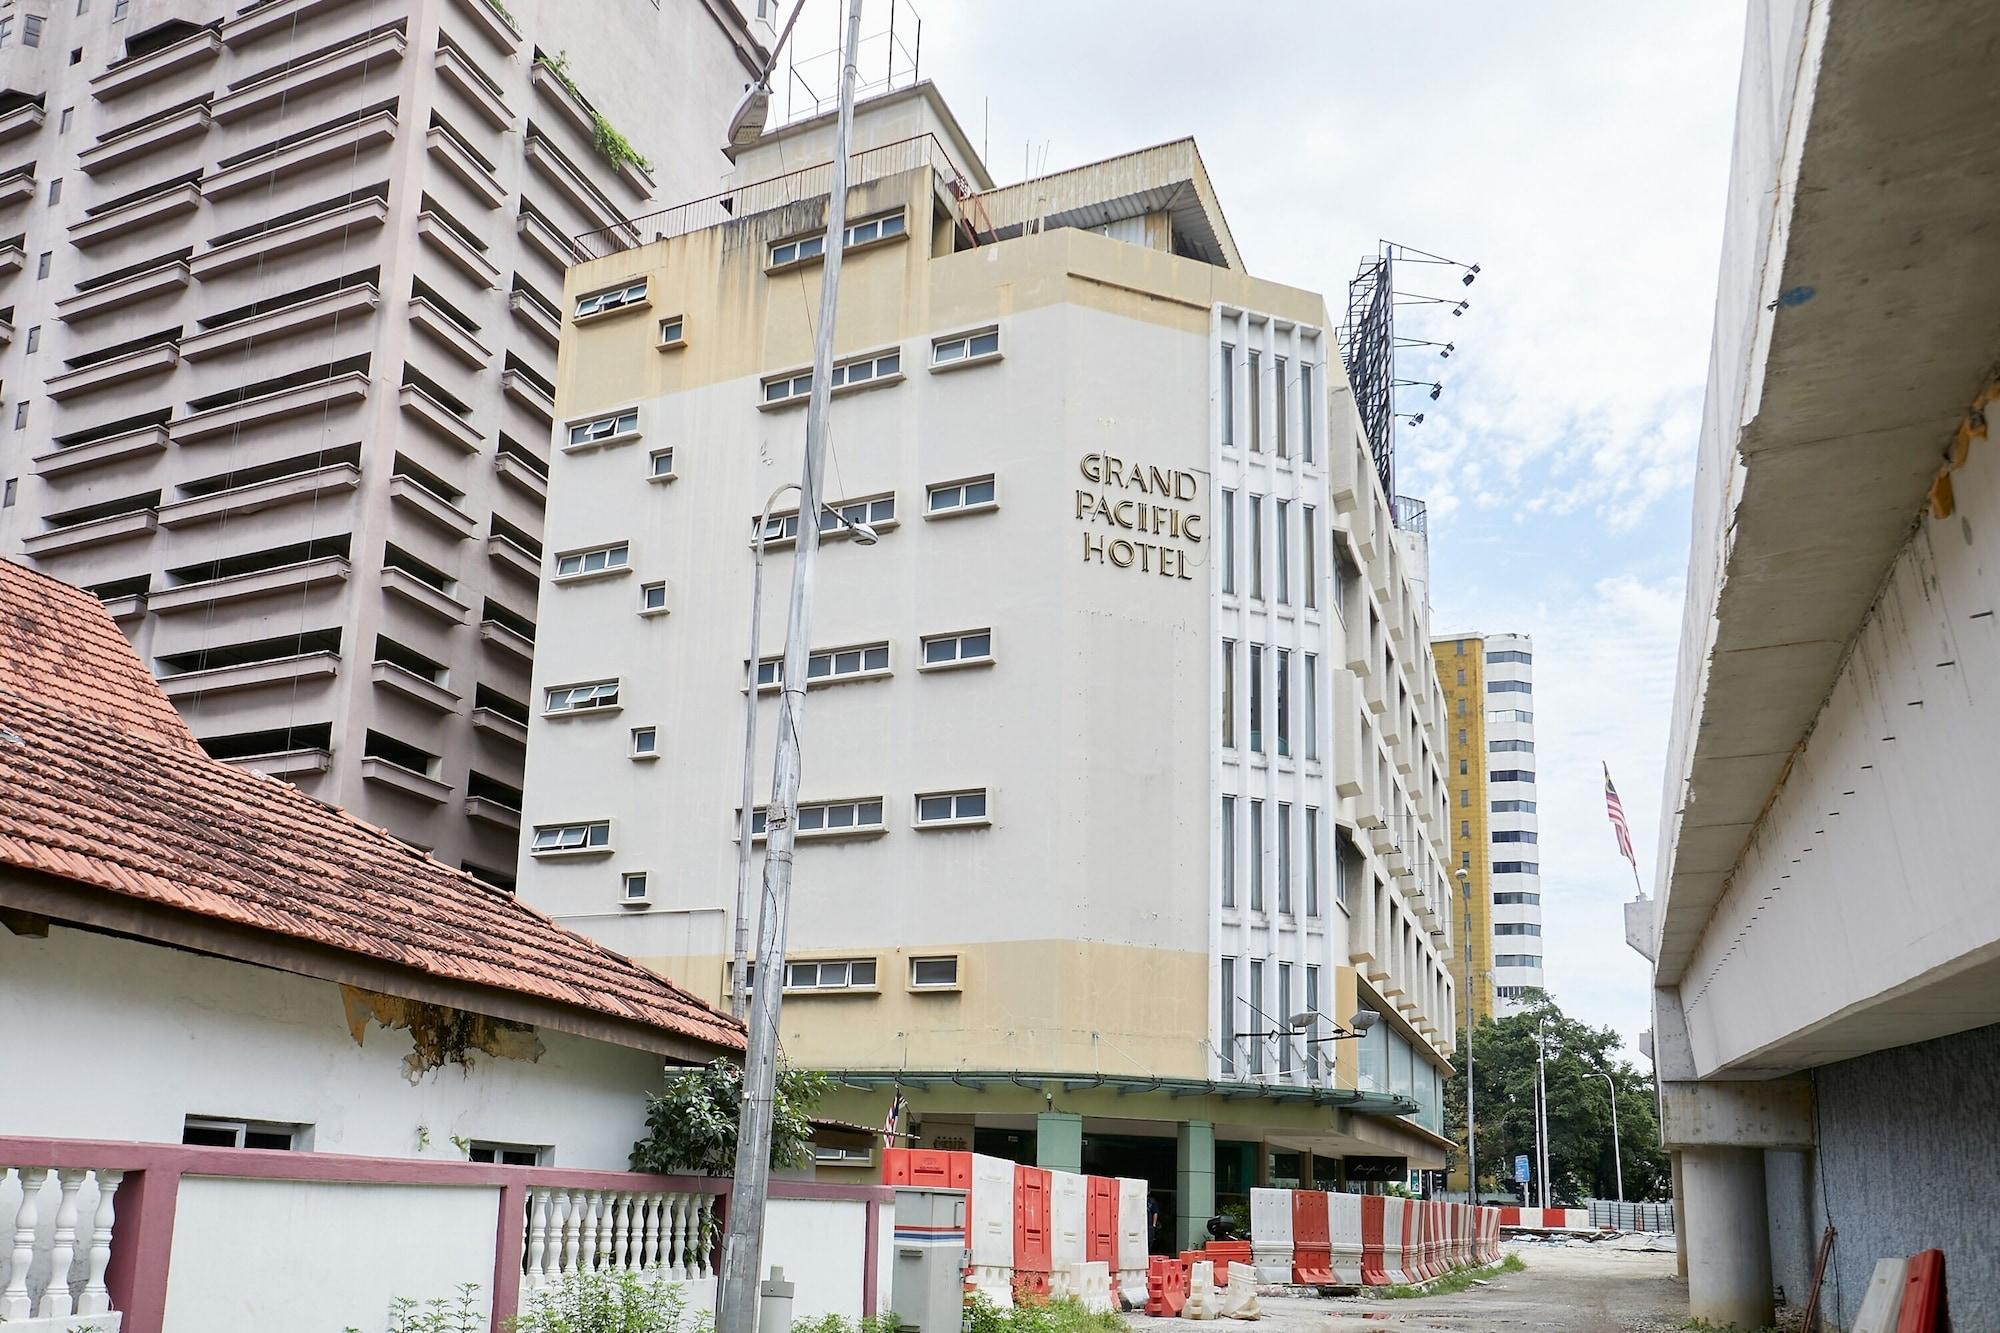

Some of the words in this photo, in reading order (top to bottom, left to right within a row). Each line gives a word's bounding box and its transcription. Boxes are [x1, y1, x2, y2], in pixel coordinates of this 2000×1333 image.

[1080, 452, 1197, 501] GRAND
[1075, 489, 1201, 543] PACIFIC
[1083, 531, 1193, 581] HOTEL
